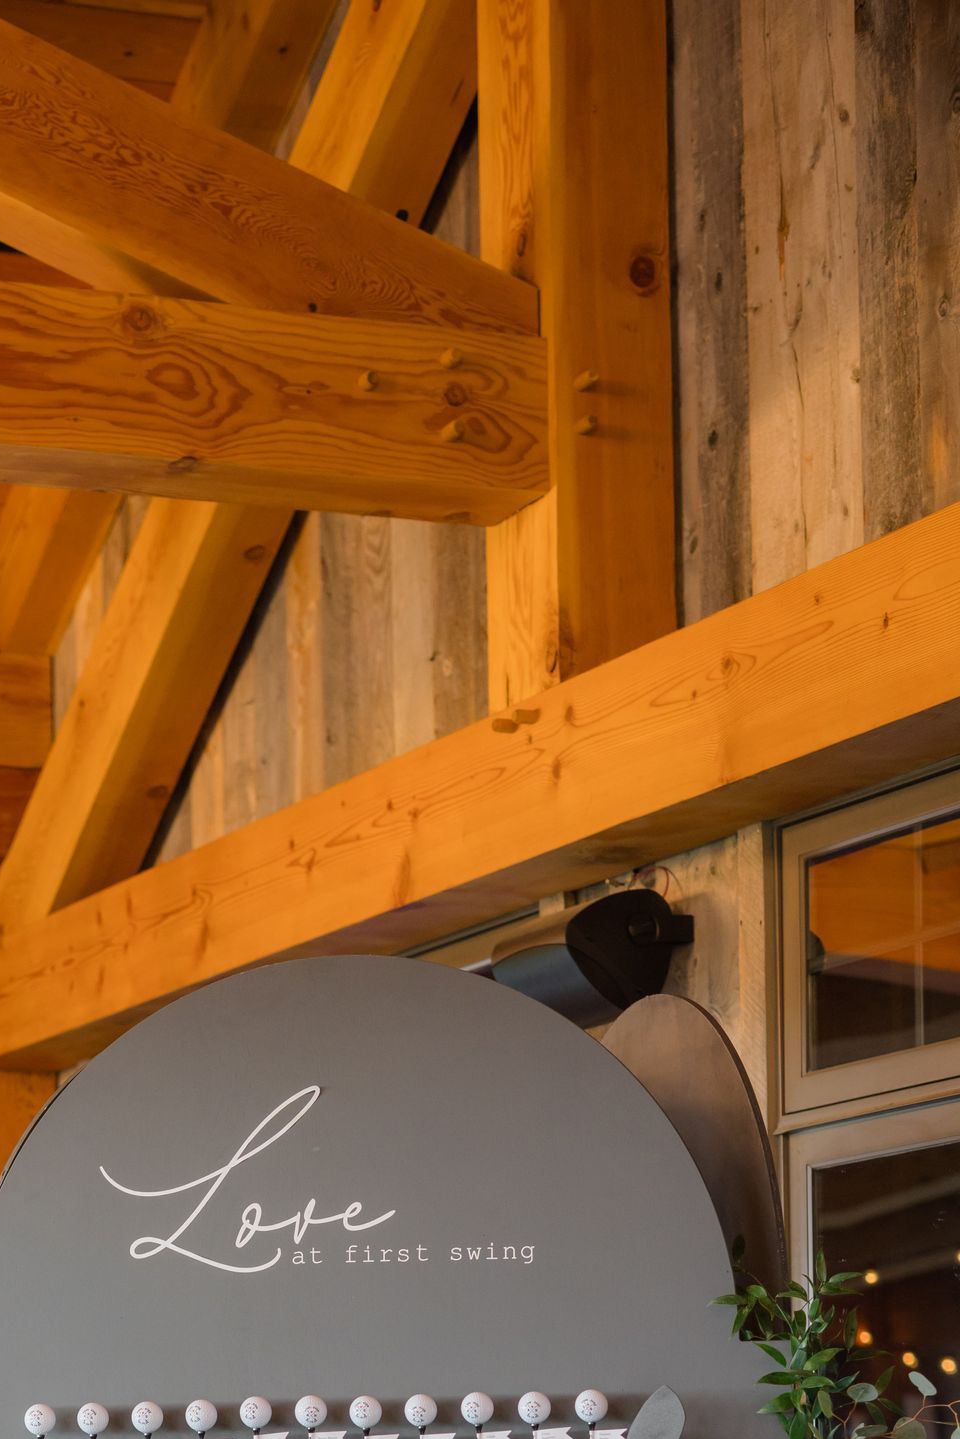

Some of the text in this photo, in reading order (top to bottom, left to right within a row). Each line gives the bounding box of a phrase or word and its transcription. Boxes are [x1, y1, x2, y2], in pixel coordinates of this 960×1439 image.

[99, 1085, 396, 1274] Love
[291, 1242, 535, 1265] at first swing
